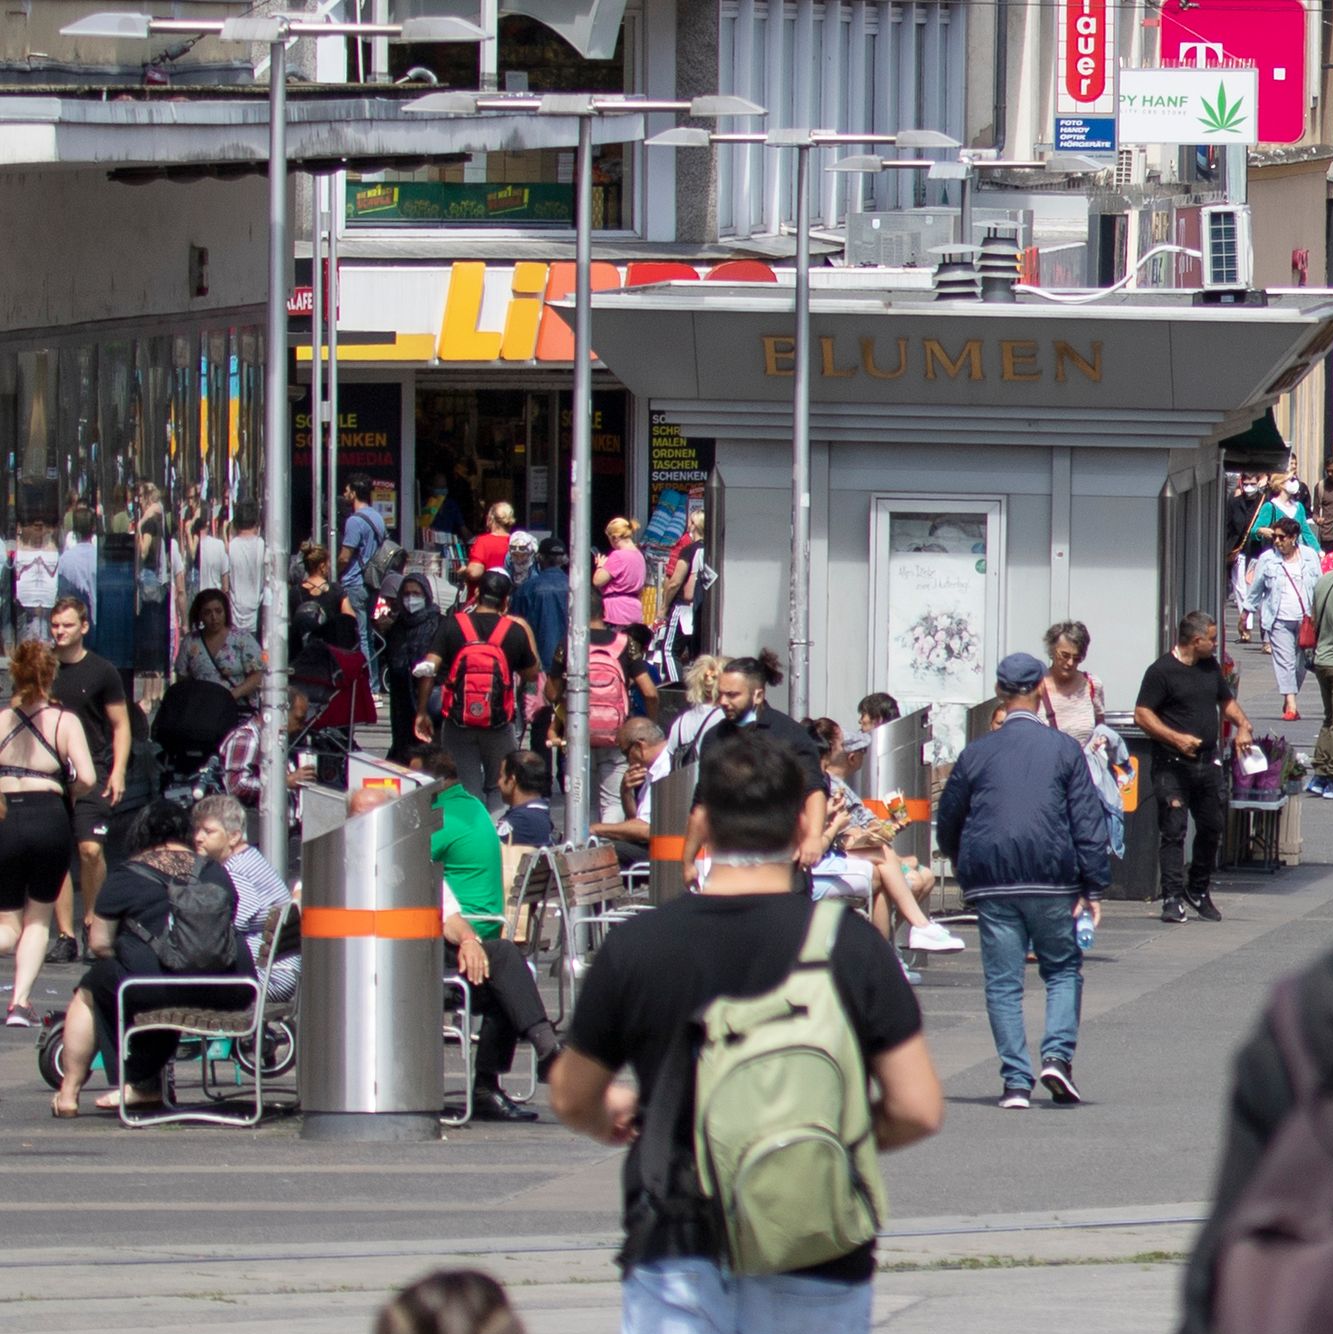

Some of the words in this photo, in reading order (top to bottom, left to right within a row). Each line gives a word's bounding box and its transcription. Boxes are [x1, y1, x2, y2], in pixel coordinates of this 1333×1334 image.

[1141, 96, 1189, 108] HANF
[1059, 119, 1084, 127] FOTO
[652, 437, 687, 447] MALEN
[652, 448, 696, 459] ORDNEN
[652, 459, 698, 470] TASCHEN
[651, 470, 708, 481] SCHENKEN
